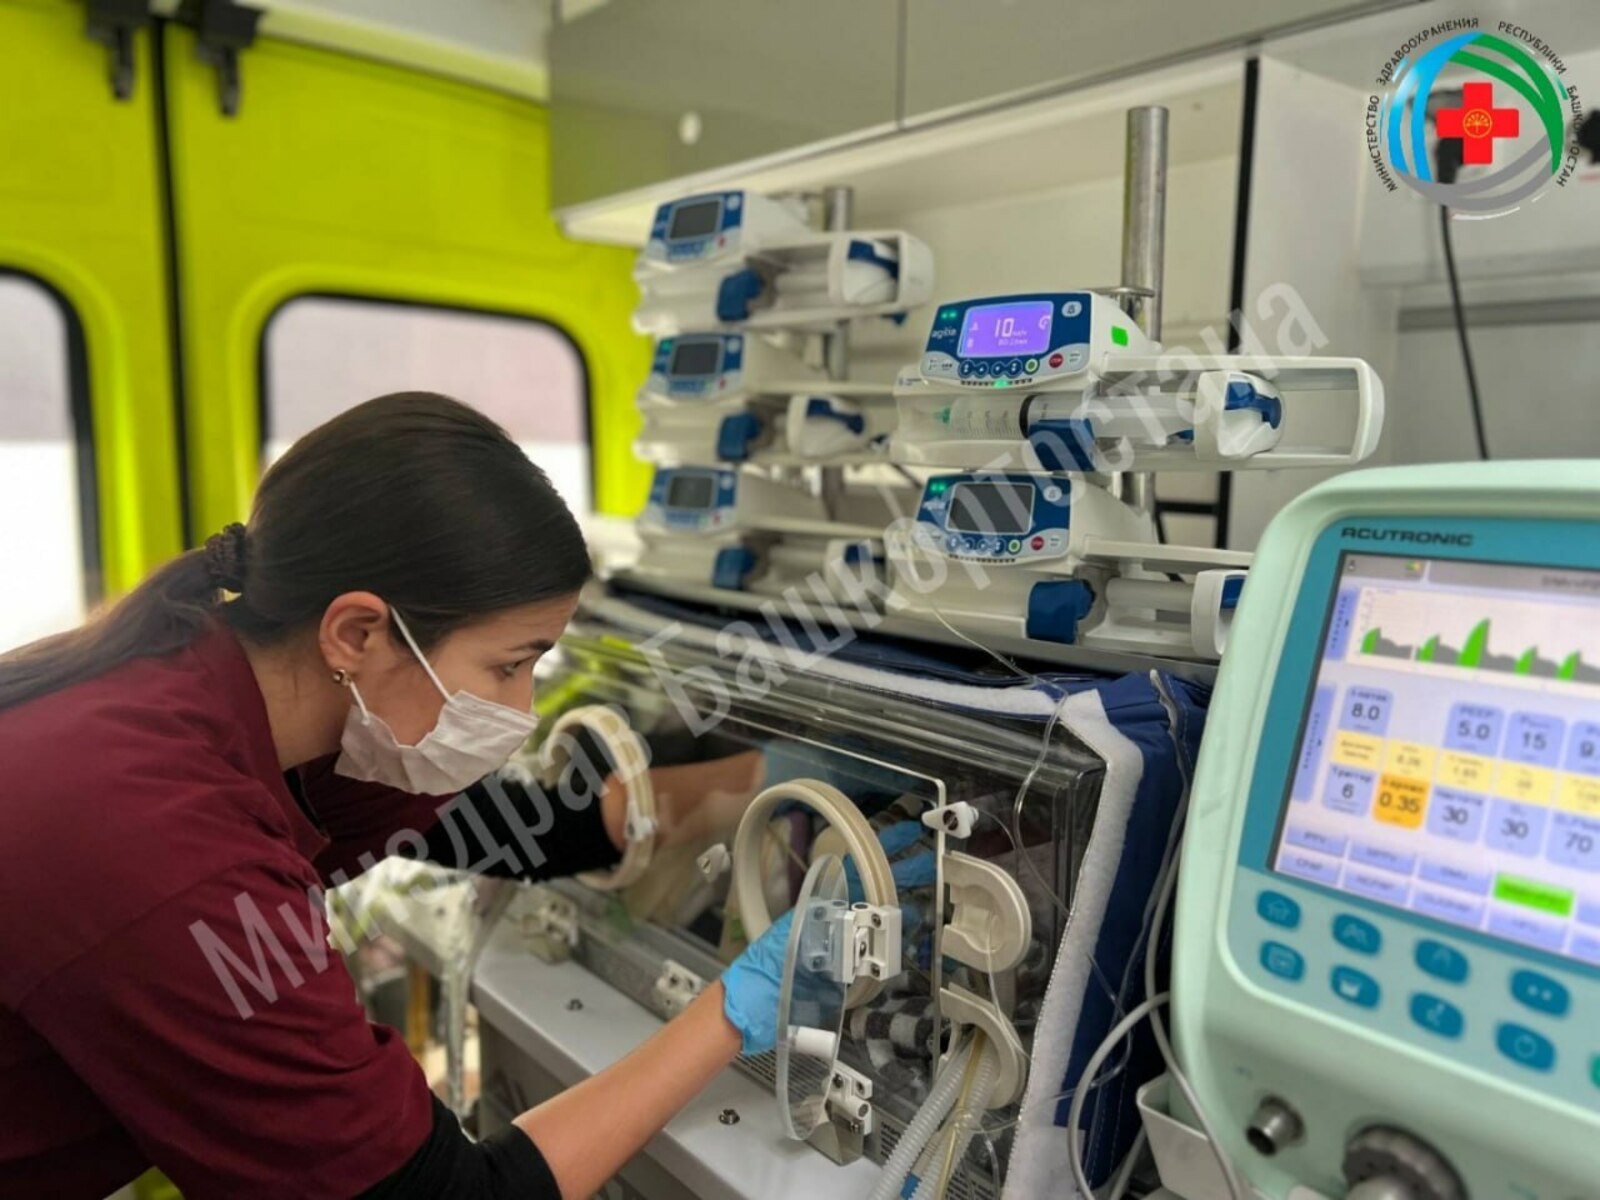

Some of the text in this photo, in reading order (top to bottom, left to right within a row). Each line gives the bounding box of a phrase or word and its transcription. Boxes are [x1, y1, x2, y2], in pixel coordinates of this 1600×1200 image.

[994, 318, 1014, 338] 10
[1341, 527, 1473, 547] ACUTRONIC
[1351, 702, 1380, 721] 8.0
[1457, 719, 1491, 741] 5.0
[1522, 731, 1548, 751] 15
[1341, 782, 1354, 800] 6
[1379, 791, 1420, 815] 0.35
[1442, 804, 1469, 826] 30
[1501, 817, 1529, 839] 30
[1566, 831, 1594, 854] 70
